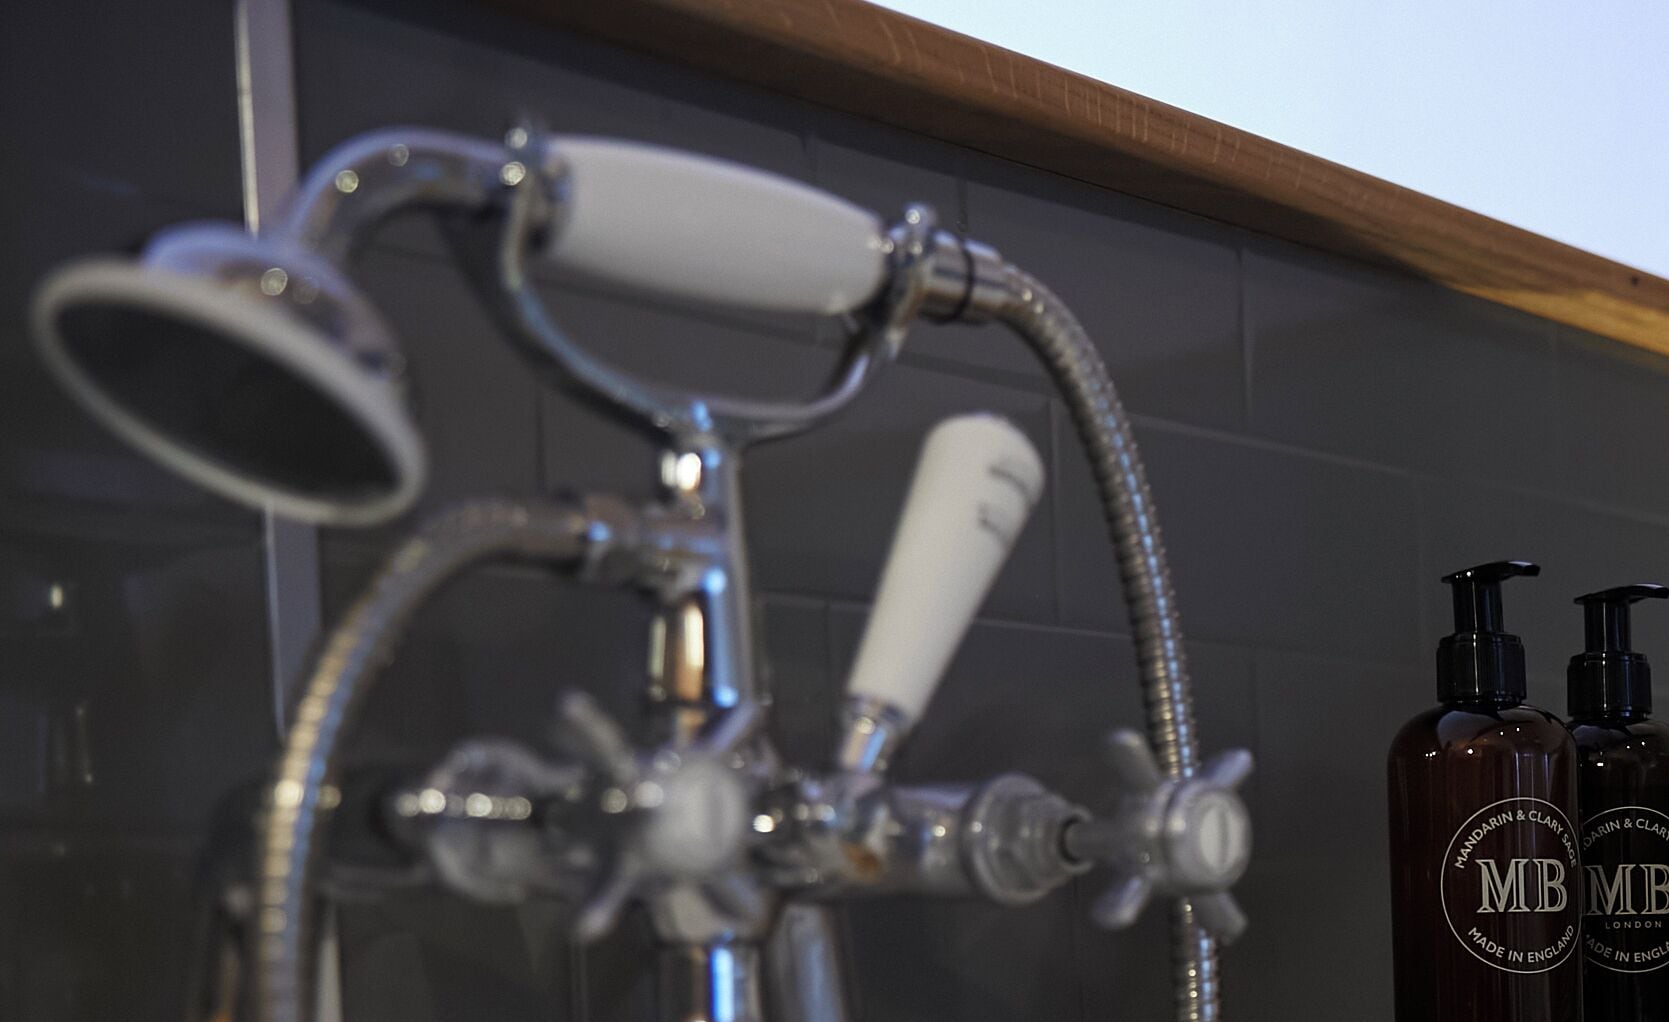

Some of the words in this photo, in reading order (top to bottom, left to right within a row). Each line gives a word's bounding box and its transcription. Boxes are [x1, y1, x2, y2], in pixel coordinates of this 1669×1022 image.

[1454, 811, 1514, 869] MANDARIN
[1516, 810, 1526, 821] &
[1528, 810, 1563, 835] CLARY
[1561, 832, 1577, 868] SAGE
[1583, 819, 1620, 850] DARIN
[1623, 818, 1633, 829] &
[1475, 858, 1568, 913] MB
[1605, 921, 1662, 930] LONDON
[1468, 927, 1505, 958] MADE
[1508, 950, 1524, 962] IN
[1527, 925, 1574, 963] ENGLAND
[1586, 934, 1612, 958] ADE
[1615, 950, 1630, 963] IN
